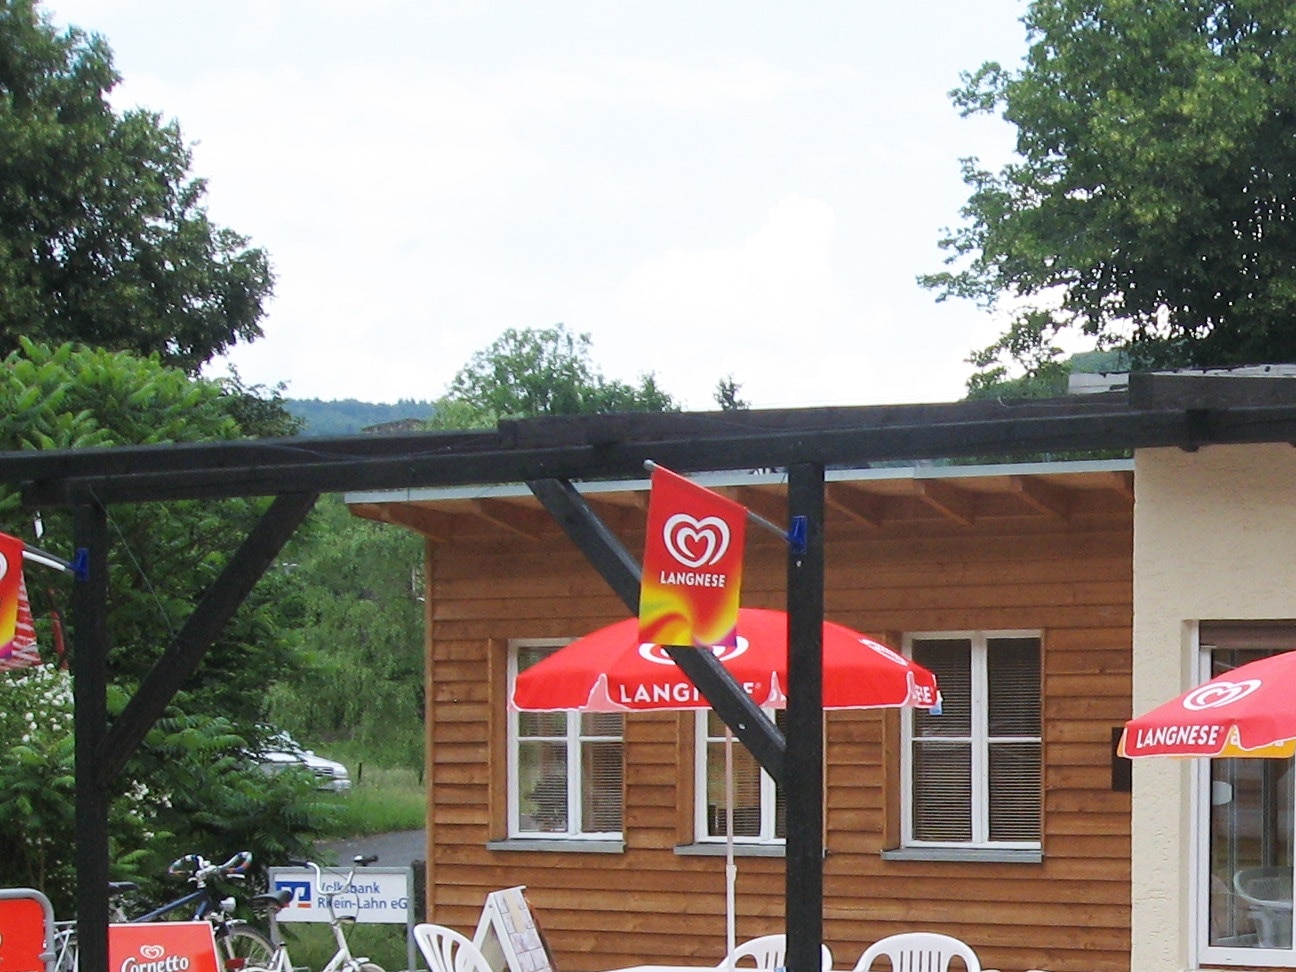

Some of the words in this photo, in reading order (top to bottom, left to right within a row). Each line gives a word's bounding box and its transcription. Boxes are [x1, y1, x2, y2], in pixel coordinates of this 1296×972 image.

[660, 570, 726, 588] LANGNESE
[619, 681, 754, 703] LANGE
[1136, 725, 1220, 749] LANGNESE
[390, 898, 408, 909] eG
